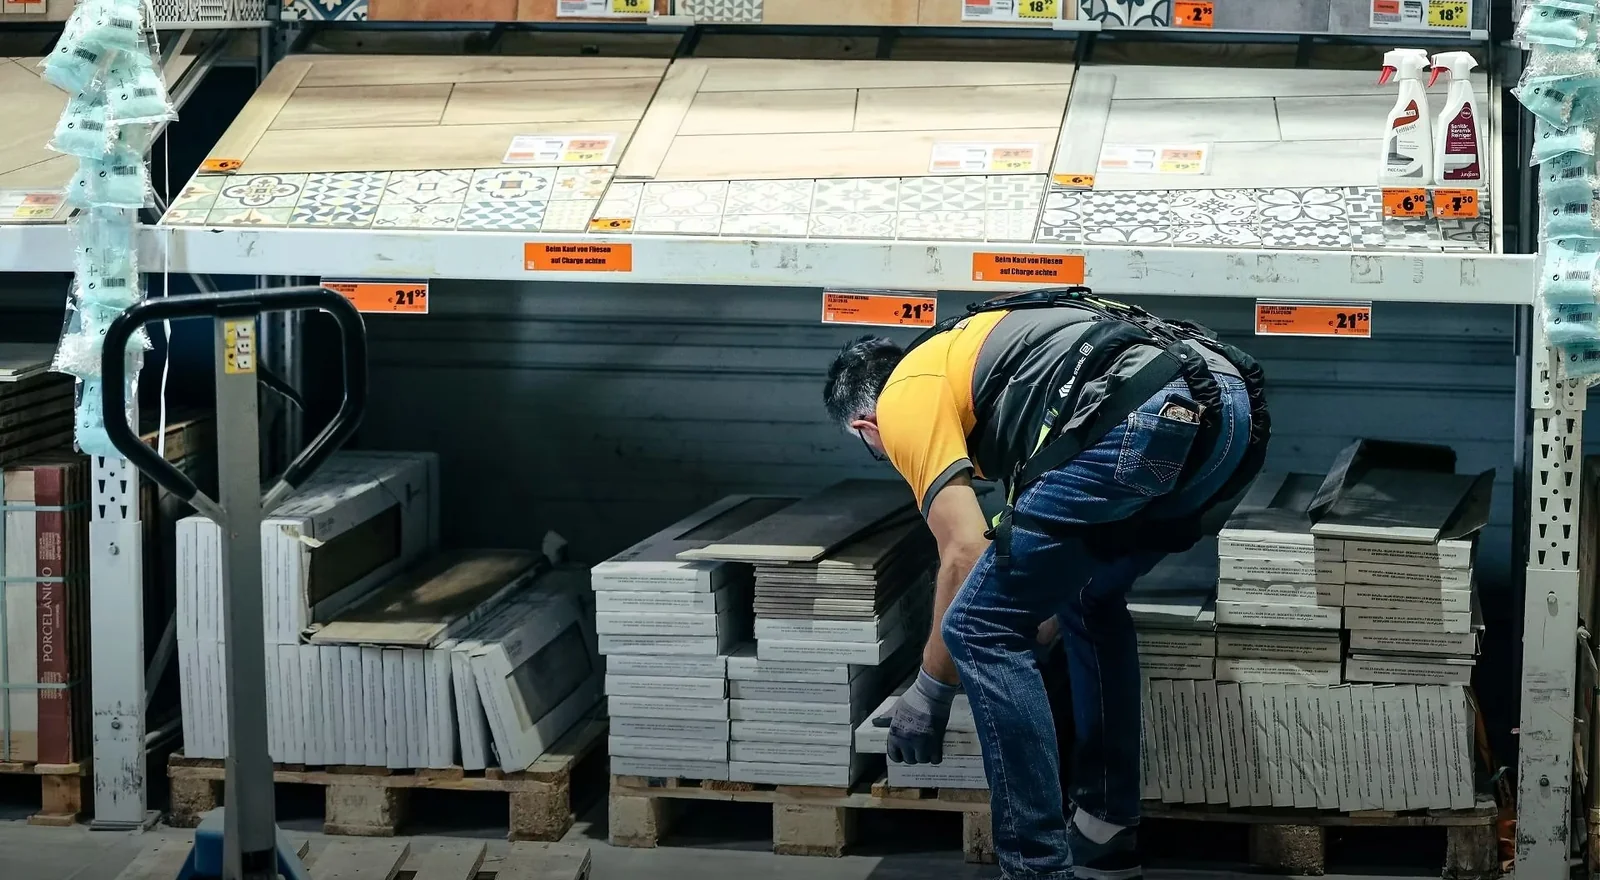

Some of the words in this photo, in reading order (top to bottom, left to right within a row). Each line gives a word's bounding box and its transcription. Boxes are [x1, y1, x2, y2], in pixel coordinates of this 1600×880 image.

[1439, 9, 1454, 20] 18
[1402, 196, 1414, 211] 6
[561, 257, 583, 265] Charge
[1012, 256, 1027, 264] Kauf
[1040, 257, 1063, 265] Fliesen
[1011, 268, 1034, 276] Charge
[1035, 268, 1058, 276] achten
[1073, 356, 1087, 376] static
